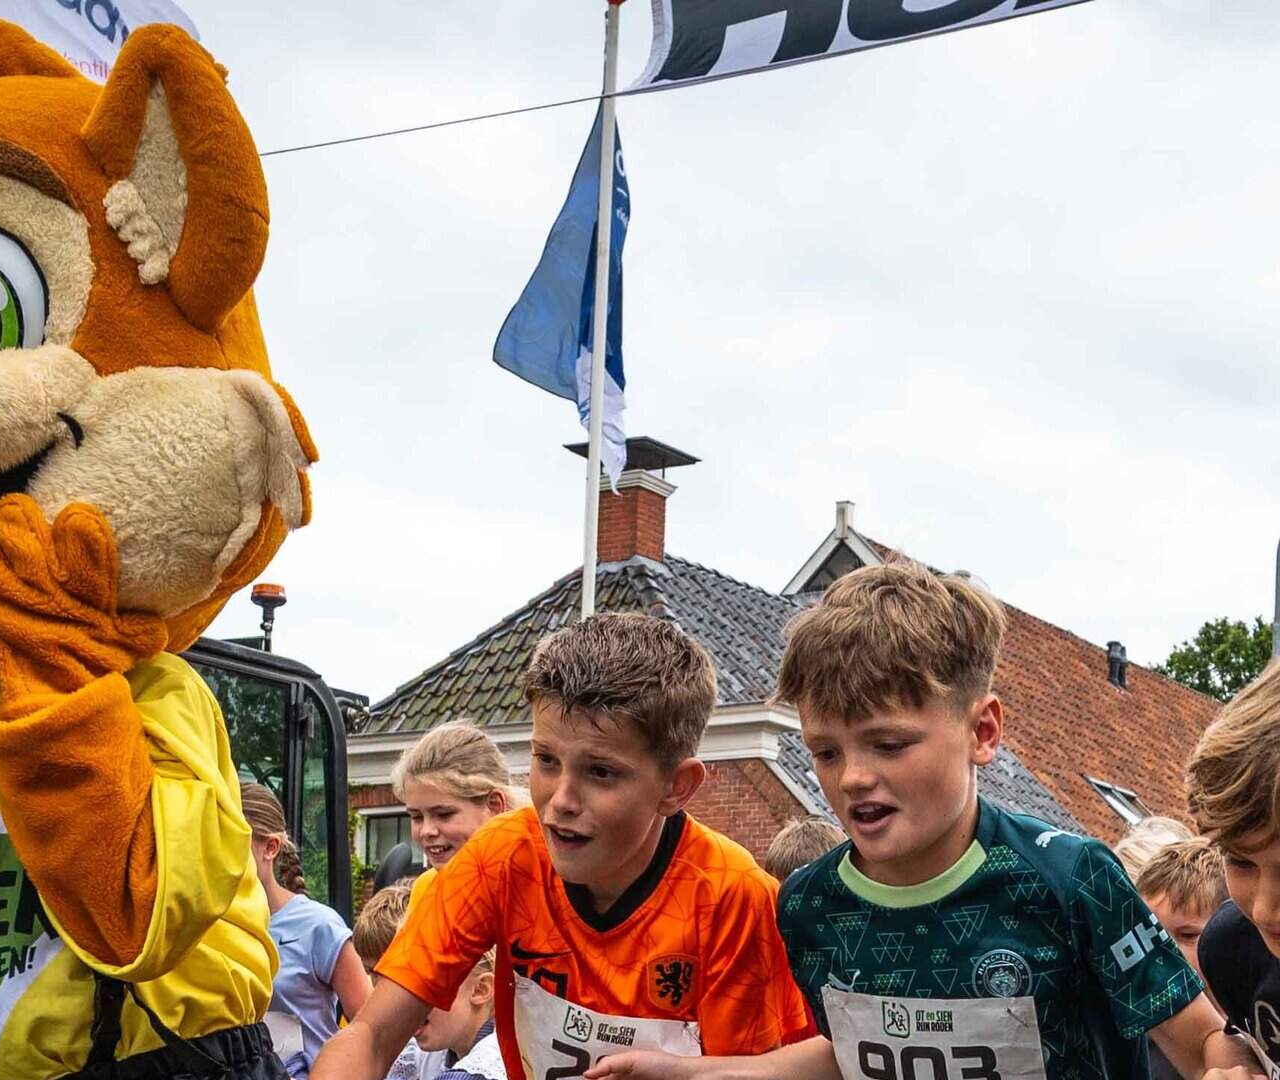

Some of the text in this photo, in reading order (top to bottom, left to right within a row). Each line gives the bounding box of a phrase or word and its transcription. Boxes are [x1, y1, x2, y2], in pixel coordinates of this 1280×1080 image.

[936, 1010, 953, 1021] SIEN
[619, 1026, 636, 1037] SIEN
[916, 1021, 953, 1032] RUN RODEN
[596, 1032, 634, 1047] RUN RODEN
